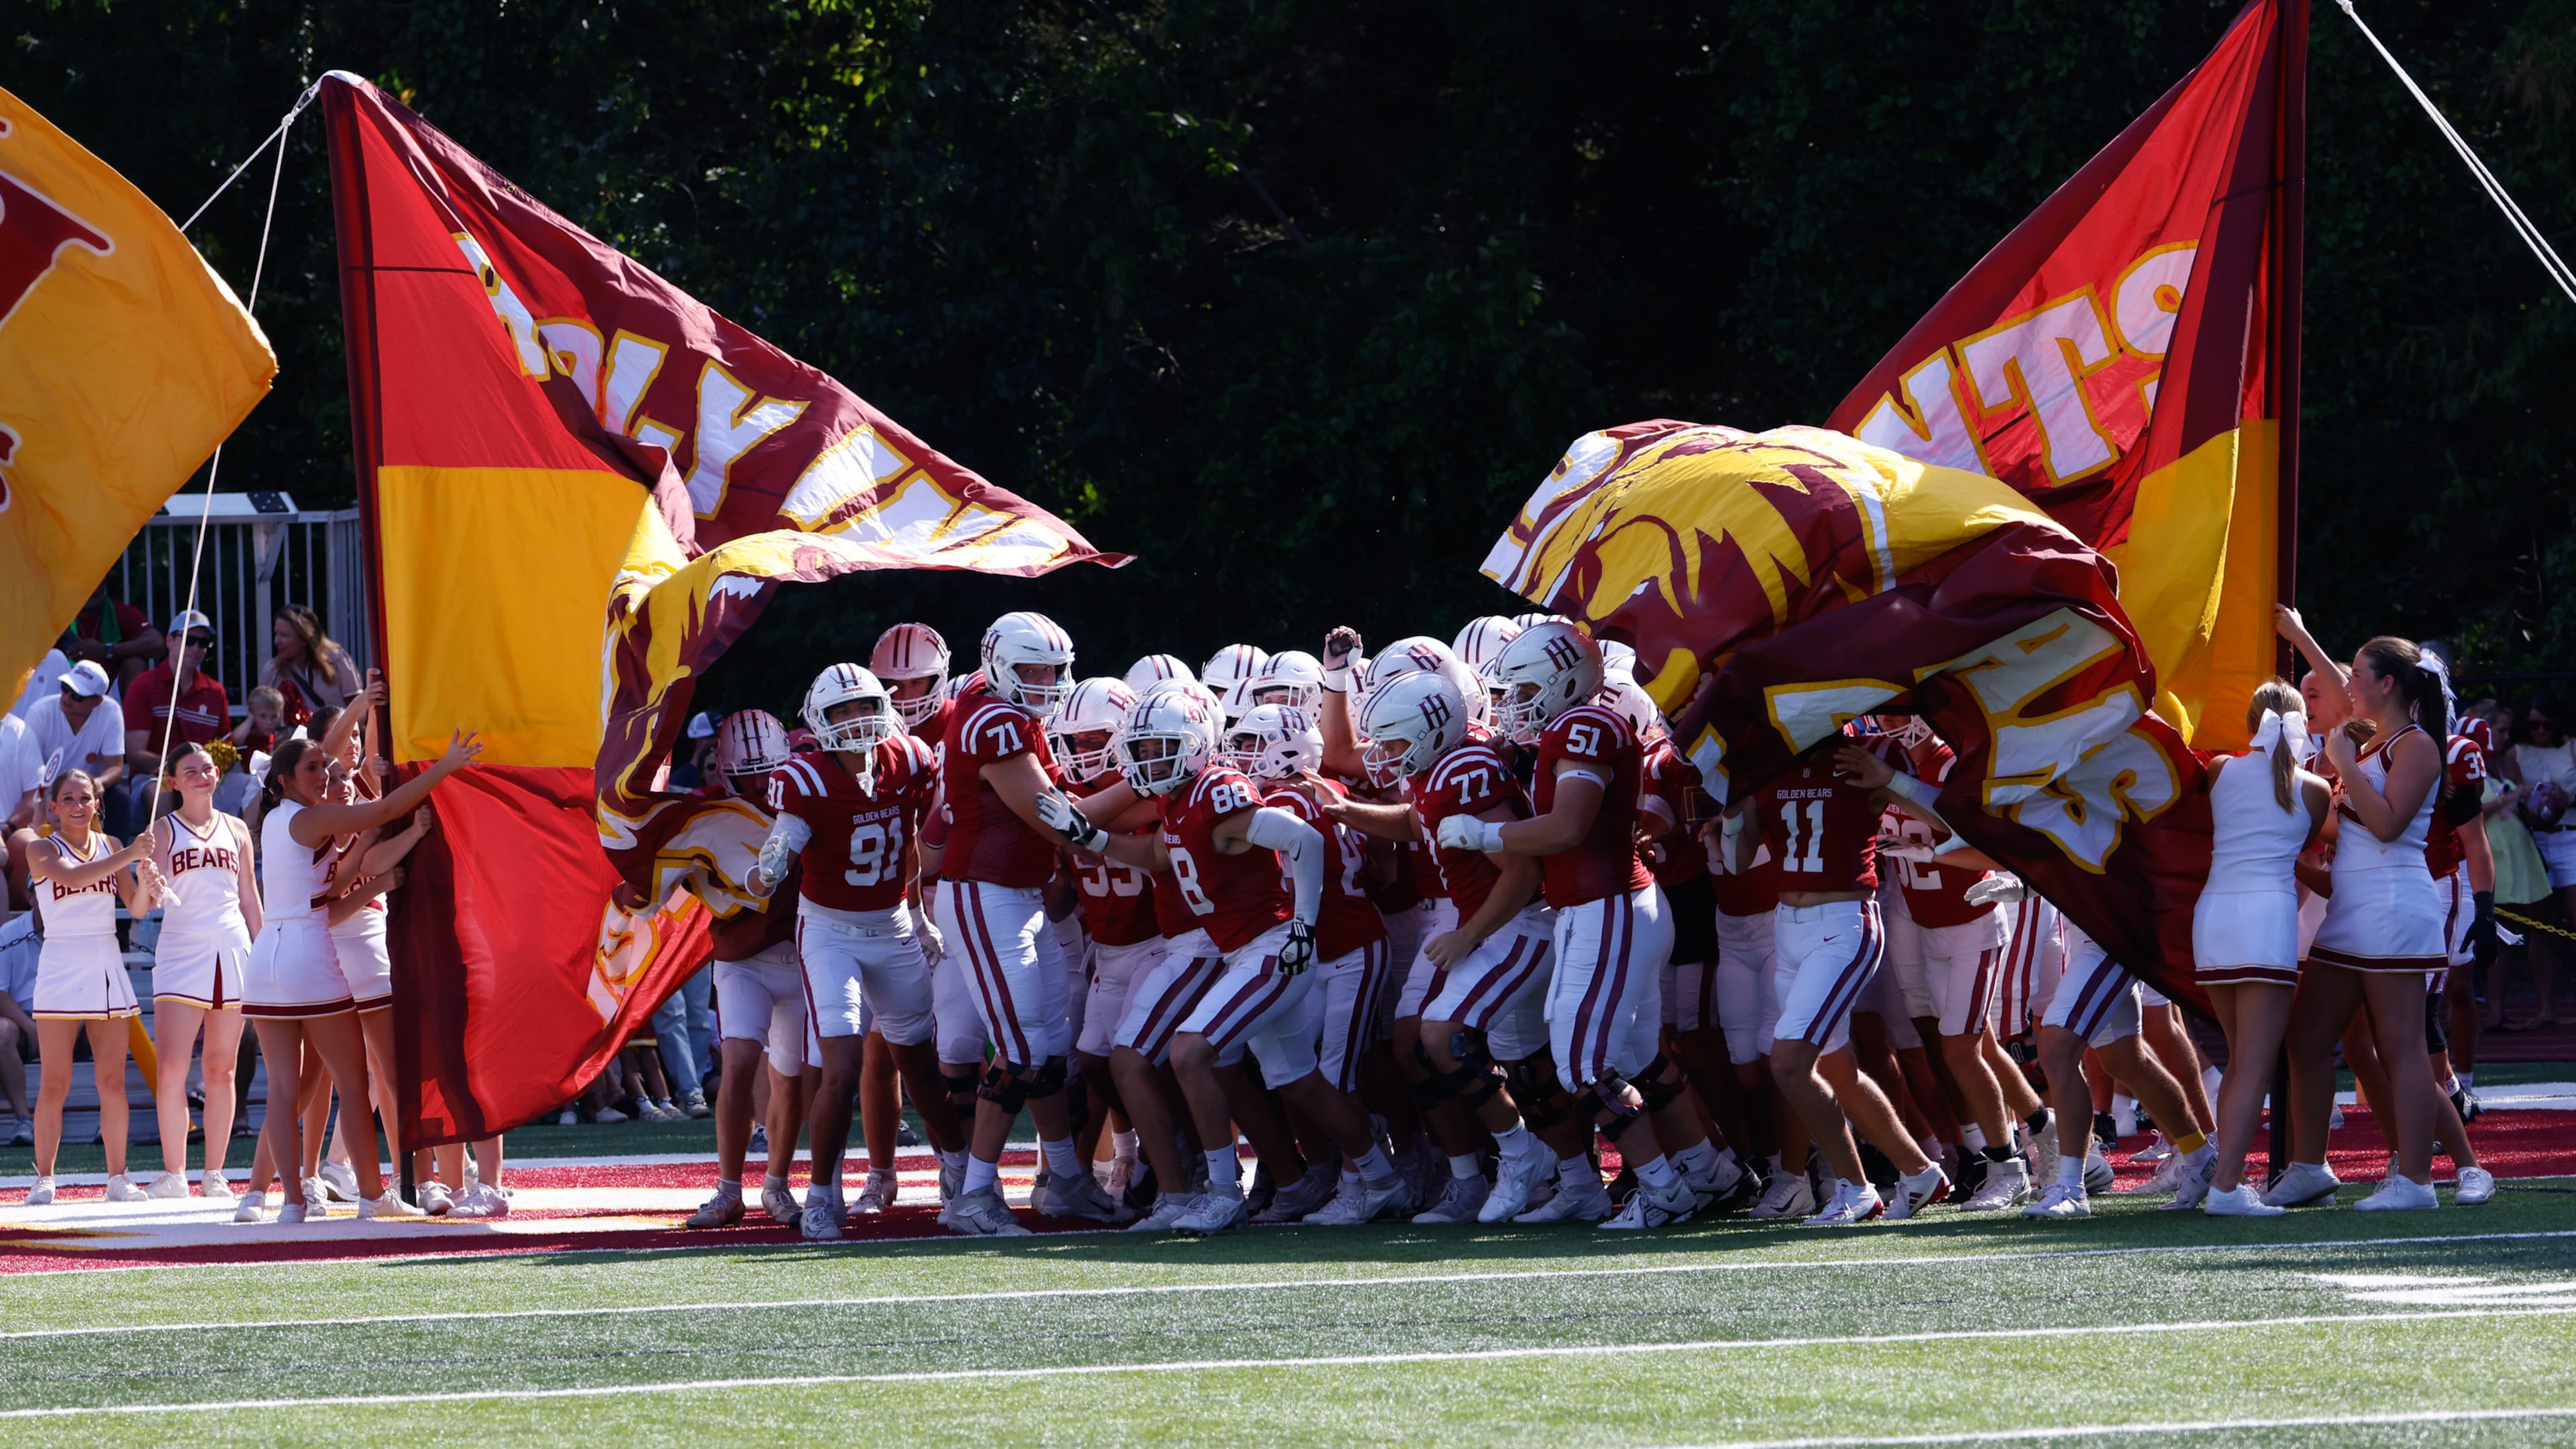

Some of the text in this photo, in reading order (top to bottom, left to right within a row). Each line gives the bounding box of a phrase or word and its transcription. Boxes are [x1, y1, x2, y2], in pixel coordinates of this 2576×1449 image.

[985, 720, 1023, 757] 71
[1566, 723, 1601, 757] 51
[767, 776, 785, 810] 91
[1210, 781, 1254, 814] 88
[1450, 767, 1491, 806] 77
[1776, 788, 1833, 800] GOLDEN BEARS
[853, 805, 900, 825] GOLDEN BEARS
[845, 816, 904, 886] 91
[1780, 800, 1825, 873] 11
[172, 847, 239, 877] BEARS
